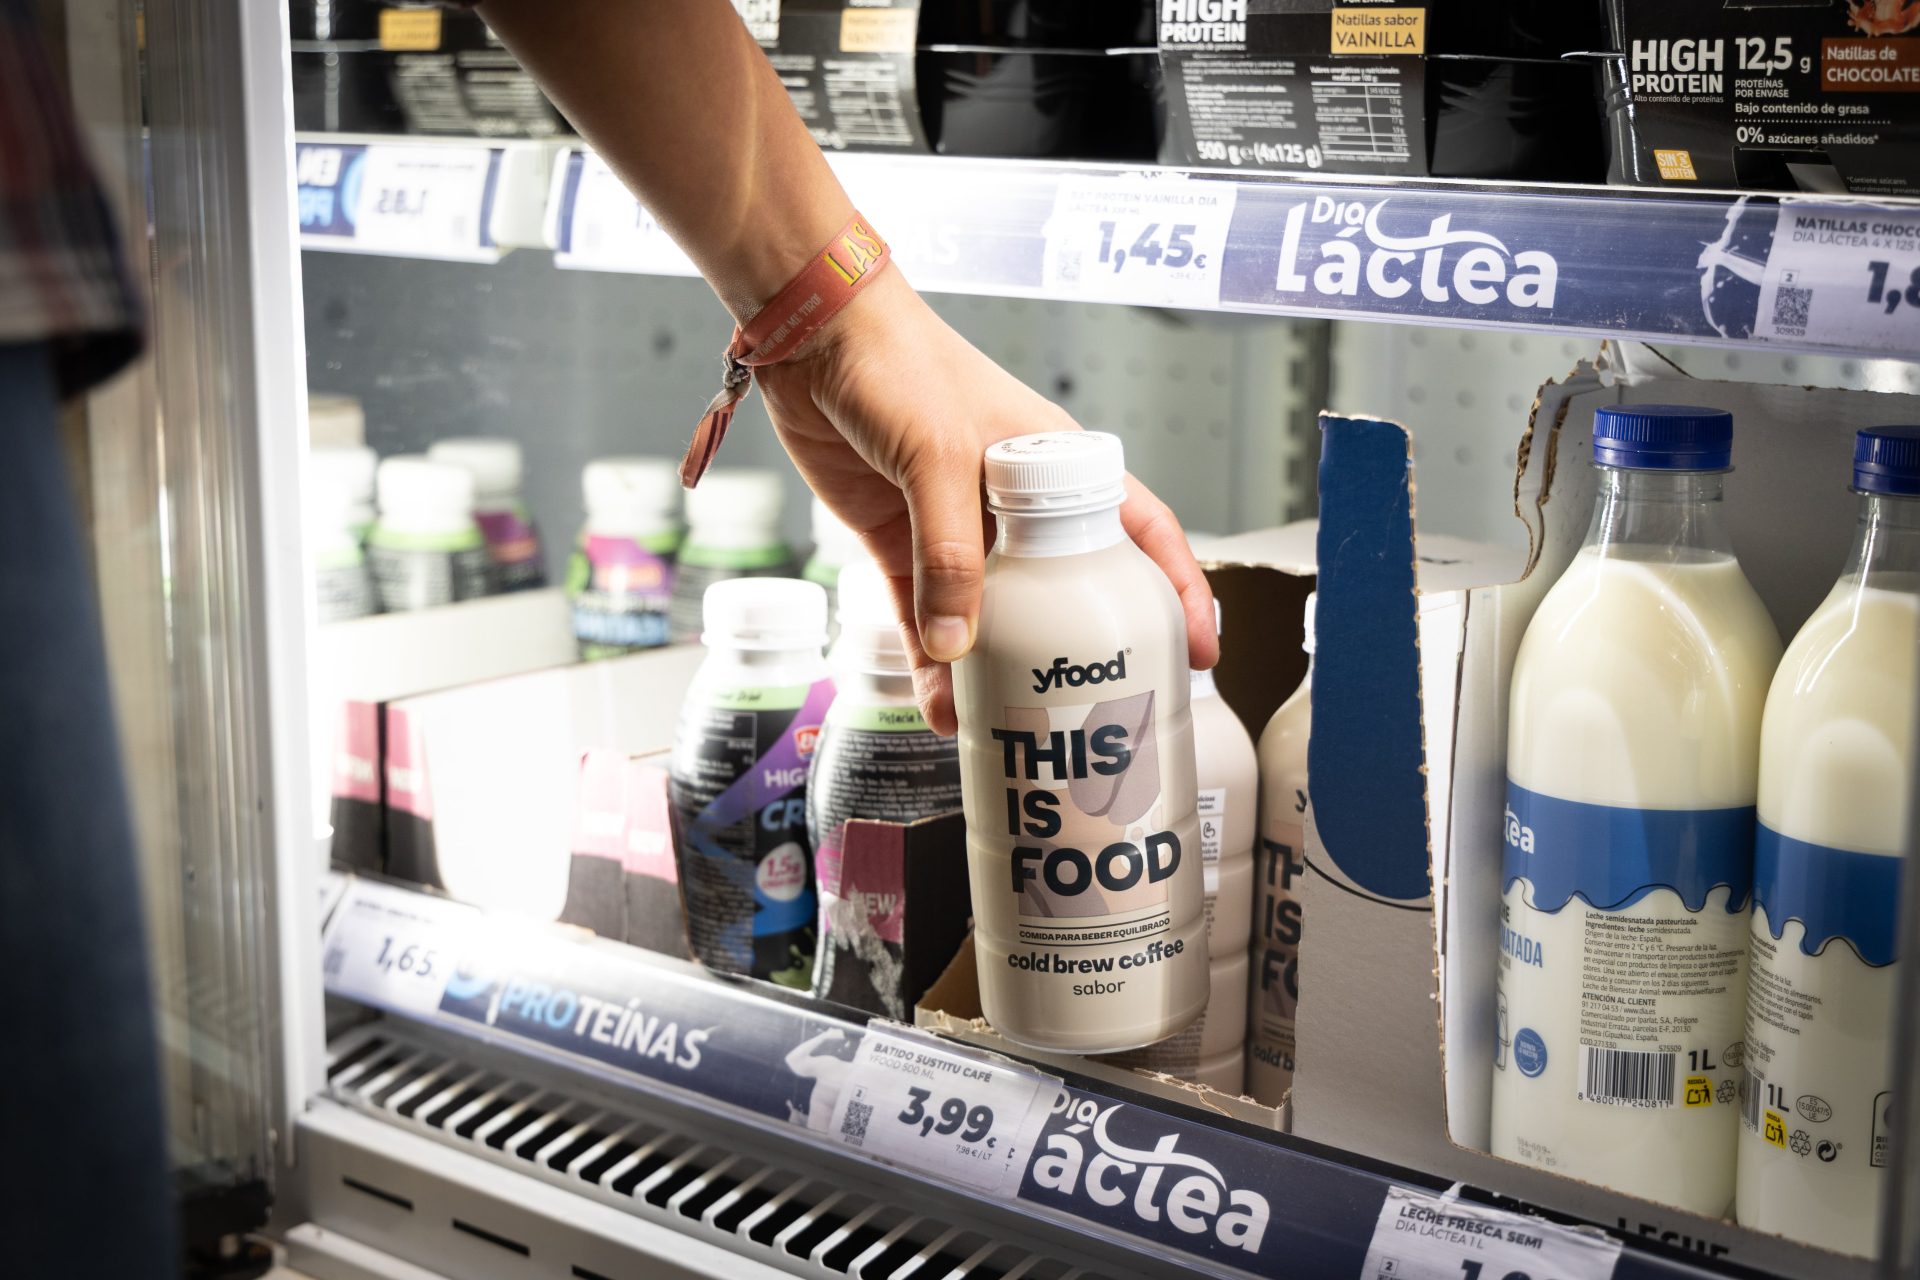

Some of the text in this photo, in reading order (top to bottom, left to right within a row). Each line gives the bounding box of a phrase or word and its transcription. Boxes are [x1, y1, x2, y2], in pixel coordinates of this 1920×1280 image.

[1161, 0, 1248, 22] HIGH
[1336, 14, 1418, 26] Natillas sabor
[1160, 22, 1246, 42] PROTEIN
[1336, 31, 1416, 48] VAINILLA
[1632, 39, 1724, 72] HIGH
[1735, 37, 1811, 76] 12,5 g
[1826, 46, 1897, 60] Natillas de
[1632, 74, 1723, 94] PROTEIN
[1735, 78, 1784, 88] PROTEÍNAS
[1826, 68, 1920, 83] CHOCOLATE
[1634, 94, 1724, 104] Alto contenido de proteínas
[1735, 89, 1789, 98] POR ENVASE
[1735, 103, 1870, 116] Bajo contenido de grasa
[1736, 126, 1765, 143] 0%
[1768, 130, 1818, 144] azúcares
[1196, 141, 1227, 160] 500
[1228, 145, 1242, 166] g
[1306, 144, 1322, 168] g)
[1656, 152, 1678, 167] SIN
[1661, 168, 1696, 178] GLUTEN
[1145, 194, 1194, 205] VAINILLA
[1198, 196, 1218, 206] DIA
[1795, 217, 1920, 238] NATILLAS CHOCO
[1792, 230, 1914, 250] DIA LÁCTEA 4 X 125
[822, 222, 883, 287] LAS
[1276, 198, 1558, 309] Láctea
[1786, 274, 1793, 282] 2
[1867, 261, 1920, 315] 1,8
[1032, 650, 1127, 694] yfood
[991, 724, 1132, 781] THIS
[764, 769, 807, 788] HIG
[1006, 787, 1062, 839] IS
[1504, 802, 1535, 854] tea
[1010, 830, 1182, 897] FOOD
[1263, 837, 1304, 891] TH
[1265, 894, 1302, 945] IS
[1585, 911, 1604, 920] Leche
[1605, 915, 1654, 925] semidesnatada
[1585, 920, 1645, 933] Ingredientes: leche
[1019, 917, 1170, 942] COMIDA PARA BEBER EQUILIBRADO
[1585, 929, 1604, 939] Origen
[1640, 934, 1662, 943] España.
[1500, 922, 1544, 968] NATADA
[1584, 938, 1613, 948] Conservar
[1614, 942, 1630, 950] entre
[1666, 944, 1694, 952] Preservar
[1584, 946, 1592, 954] No
[1594, 948, 1624, 958] almacenar
[1679, 953, 1706, 961] productos
[1008, 938, 1184, 974] cold brew coffee
[1592, 958, 1615, 966] especial
[1628, 961, 1658, 969] productos
[1668, 962, 1692, 970] limpieza
[1698, 962, 1708, 970] que
[1262, 949, 1298, 1002] FO
[1584, 964, 1600, 973] olores.
[1604, 966, 1615, 974] Una
[1073, 980, 1126, 996] sabor
[1583, 973, 1608, 982] colocado
[1614, 978, 1641, 986] consumir
[1583, 981, 1600, 990] Leche
[1600, 984, 1608, 992] de
[1608, 985, 1637, 995] Bienestar
[1639, 988, 1660, 996] Animal:
[1582, 991, 1616, 1004] ATENCIÓN
[1628, 998, 1656, 1006] CLIENTE
[1785, 997, 1812, 1010] desprendan
[1581, 1010, 1624, 1022] Comercializado
[1626, 1016, 1636, 1024] por
[1590, 1002, 1656, 1015] 217 www.dia.es
[502, 973, 709, 1071] PROTEÍNAS
[1580, 1018, 1692, 1033] Industrial parcelas 20130
[868, 1055, 935, 1080] YFOOD 500 ML
[874, 1043, 993, 1083] BATIDO SUSTITU CAFÉ
[1590, 1095, 1670, 1109] 480017 240811
[956, 1144, 970, 1156] 7,98
[1032, 1104, 1270, 1254] áctea
[1395, 1219, 1416, 1234] DIA
[1420, 1225, 1466, 1244] LÁCTEA
[1477, 1239, 1484, 1249] L
[1400, 1206, 1543, 1250] LECHE FRESCA SEMI
[1386, 1261, 1393, 1271] 2
